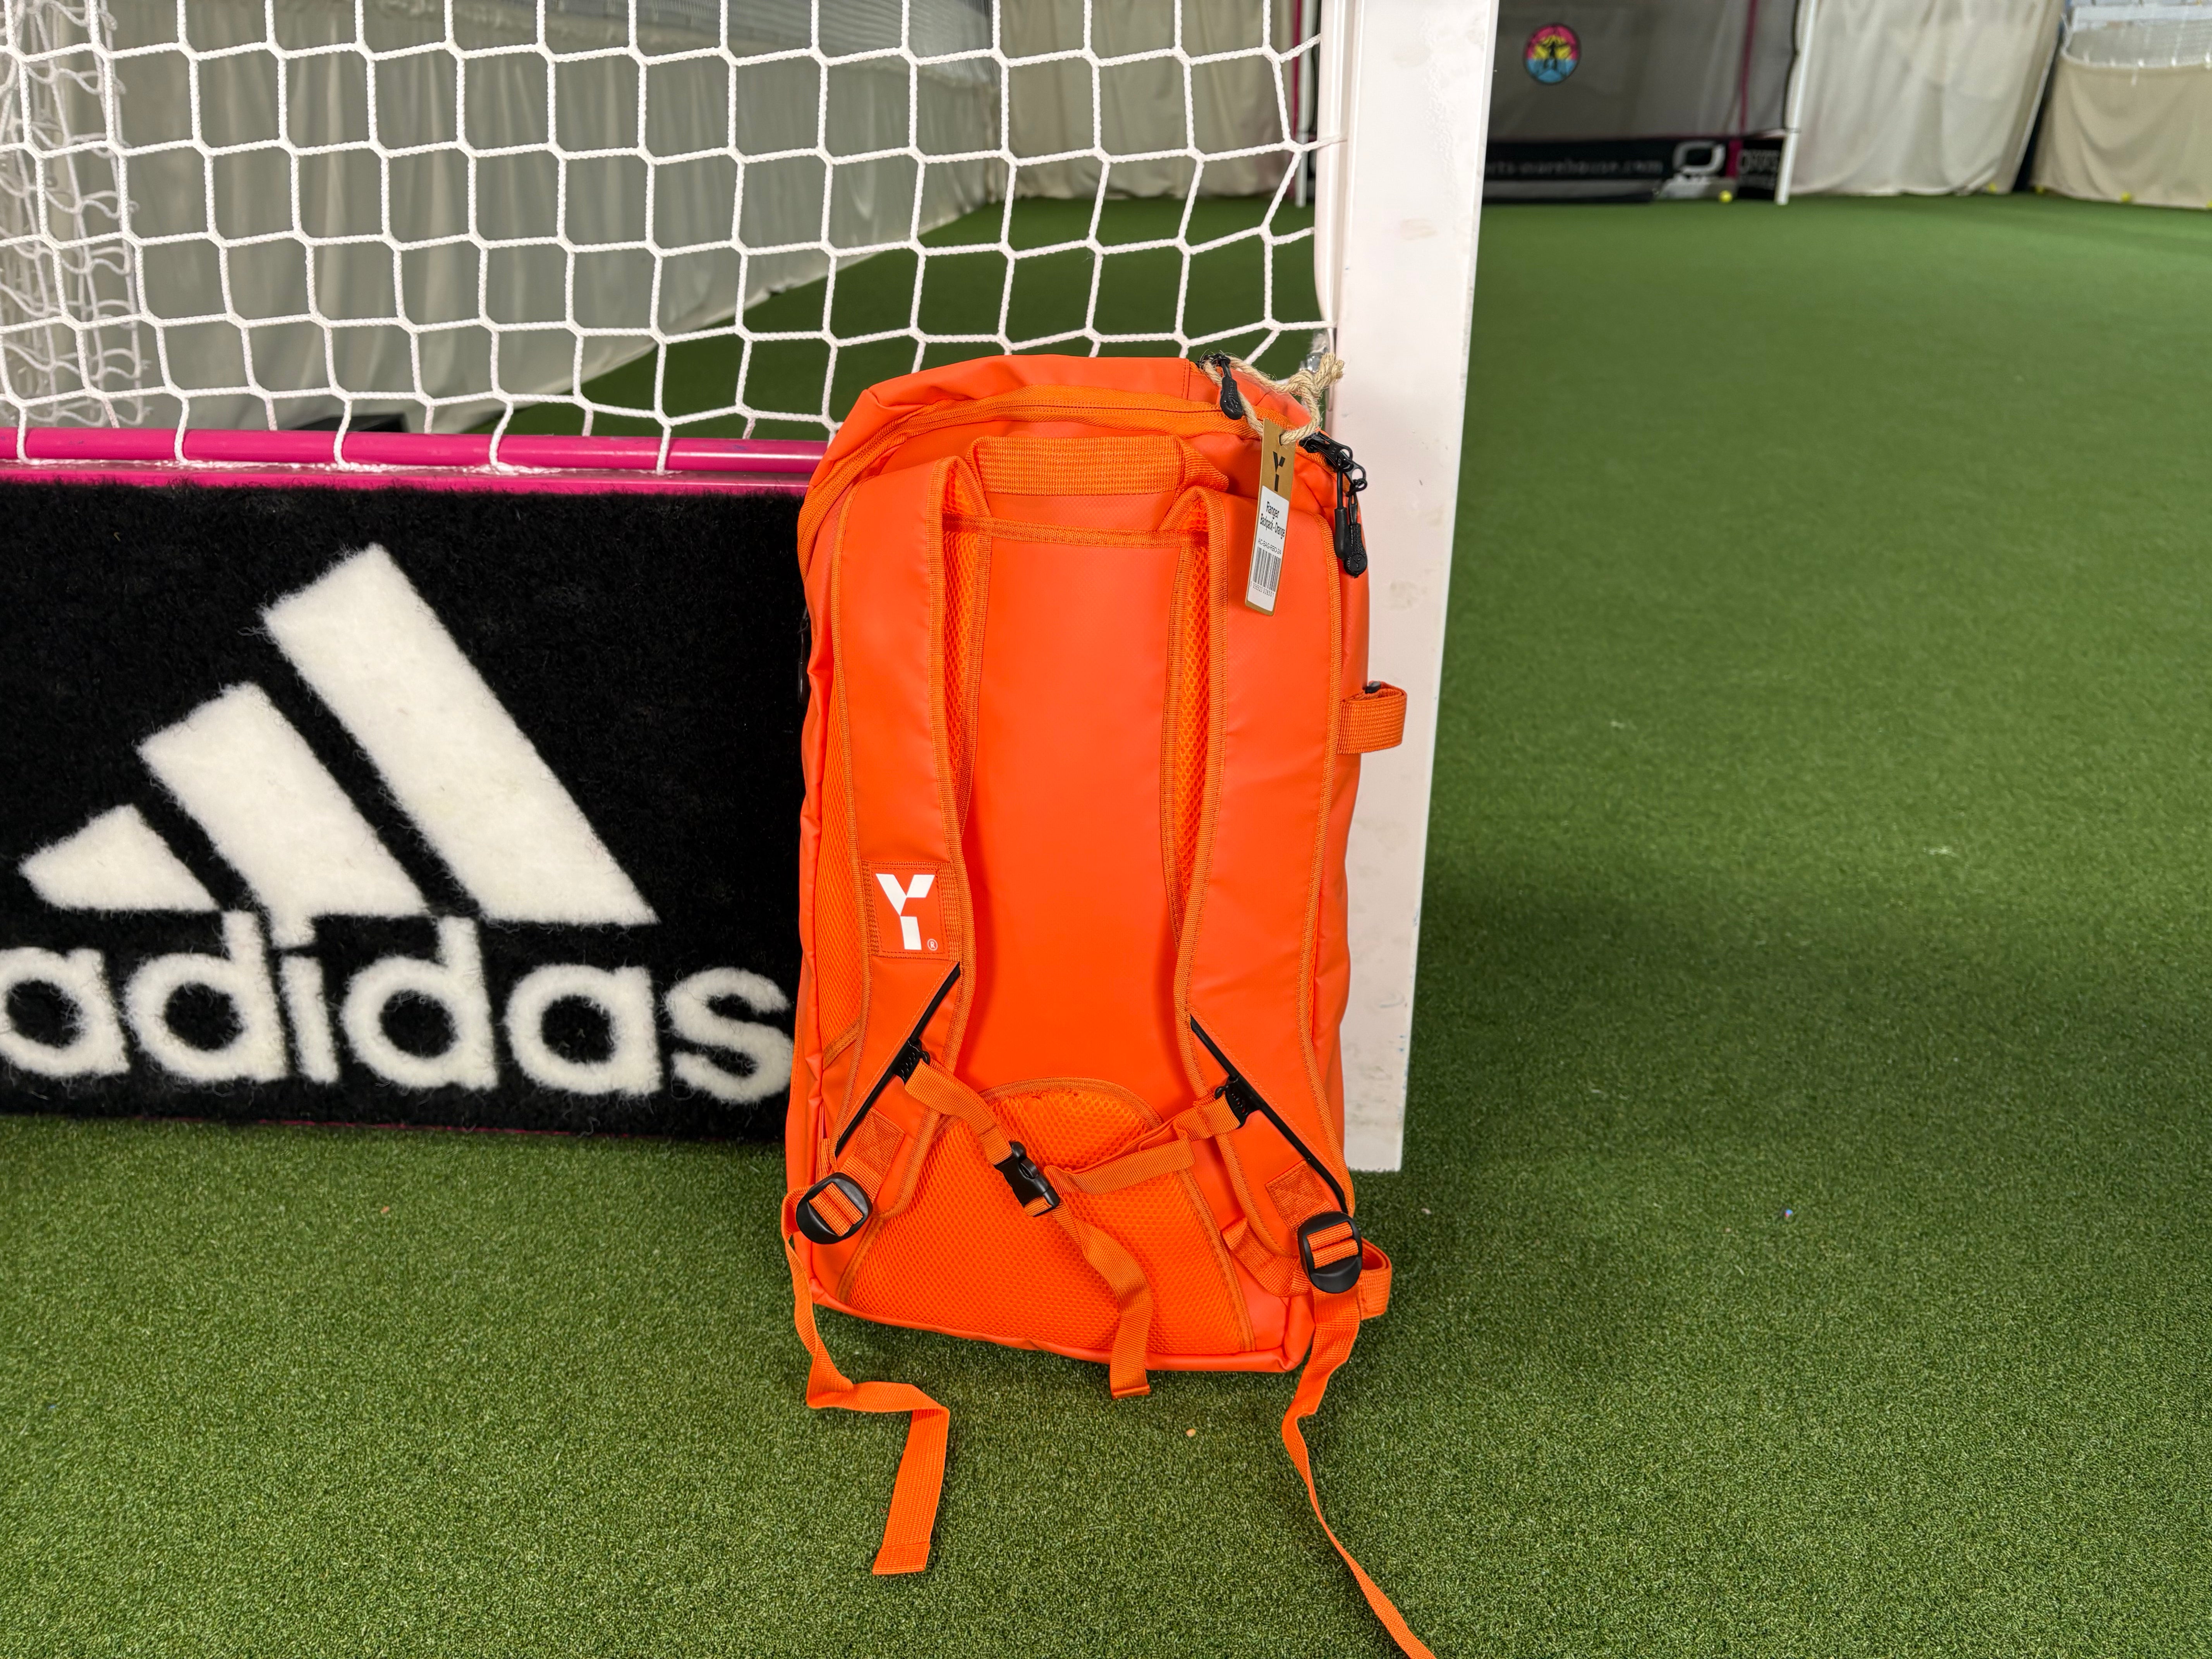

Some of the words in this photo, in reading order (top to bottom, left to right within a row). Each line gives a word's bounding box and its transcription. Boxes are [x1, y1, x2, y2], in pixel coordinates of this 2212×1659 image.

[1273, 451, 1286, 493] Y
[1266, 501, 1279, 519] Ranger
[1275, 522, 1285, 539] Orange
[0, 910, 793, 1105] adidas
